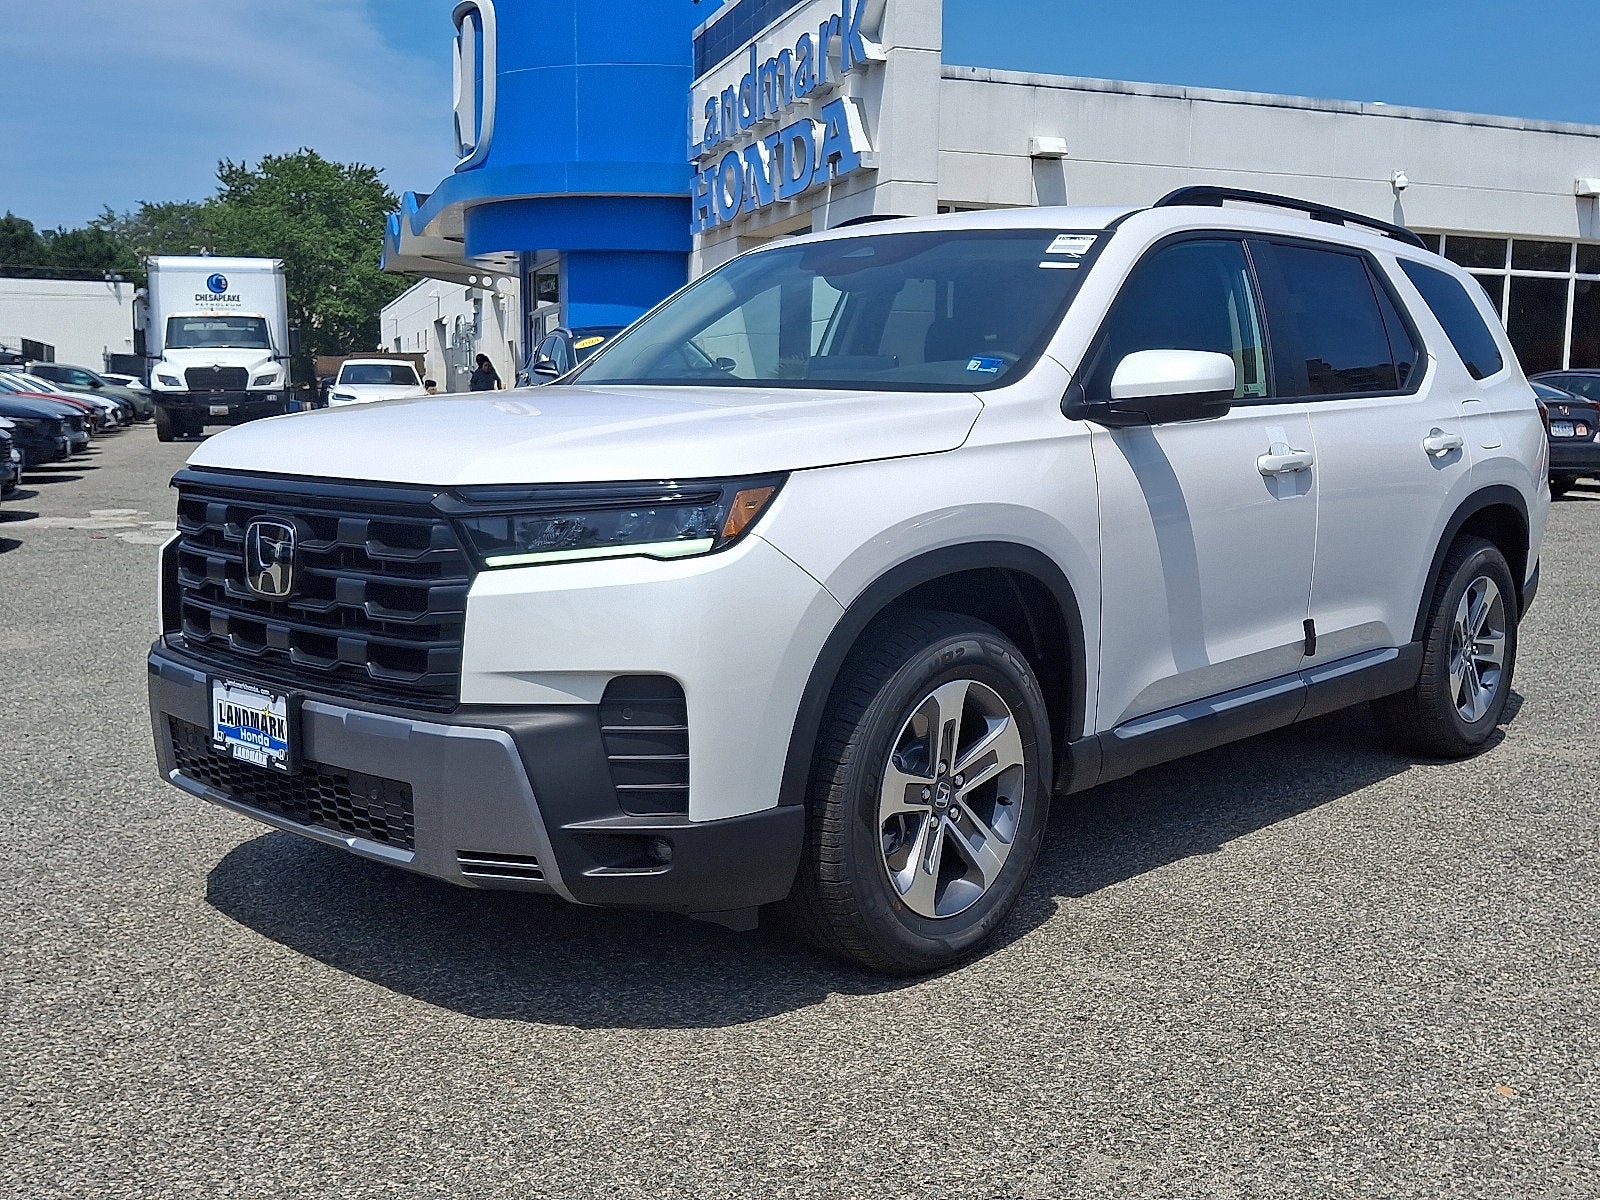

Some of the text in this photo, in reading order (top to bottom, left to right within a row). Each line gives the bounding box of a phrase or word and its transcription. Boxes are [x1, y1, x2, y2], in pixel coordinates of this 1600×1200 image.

[687, 0, 884, 163] Landmark
[690, 96, 868, 235] HONDA
[195, 294, 241, 302] CHESAPEAKE
[218, 702, 286, 740] LANDMARK
[240, 727, 269, 747] Honda
